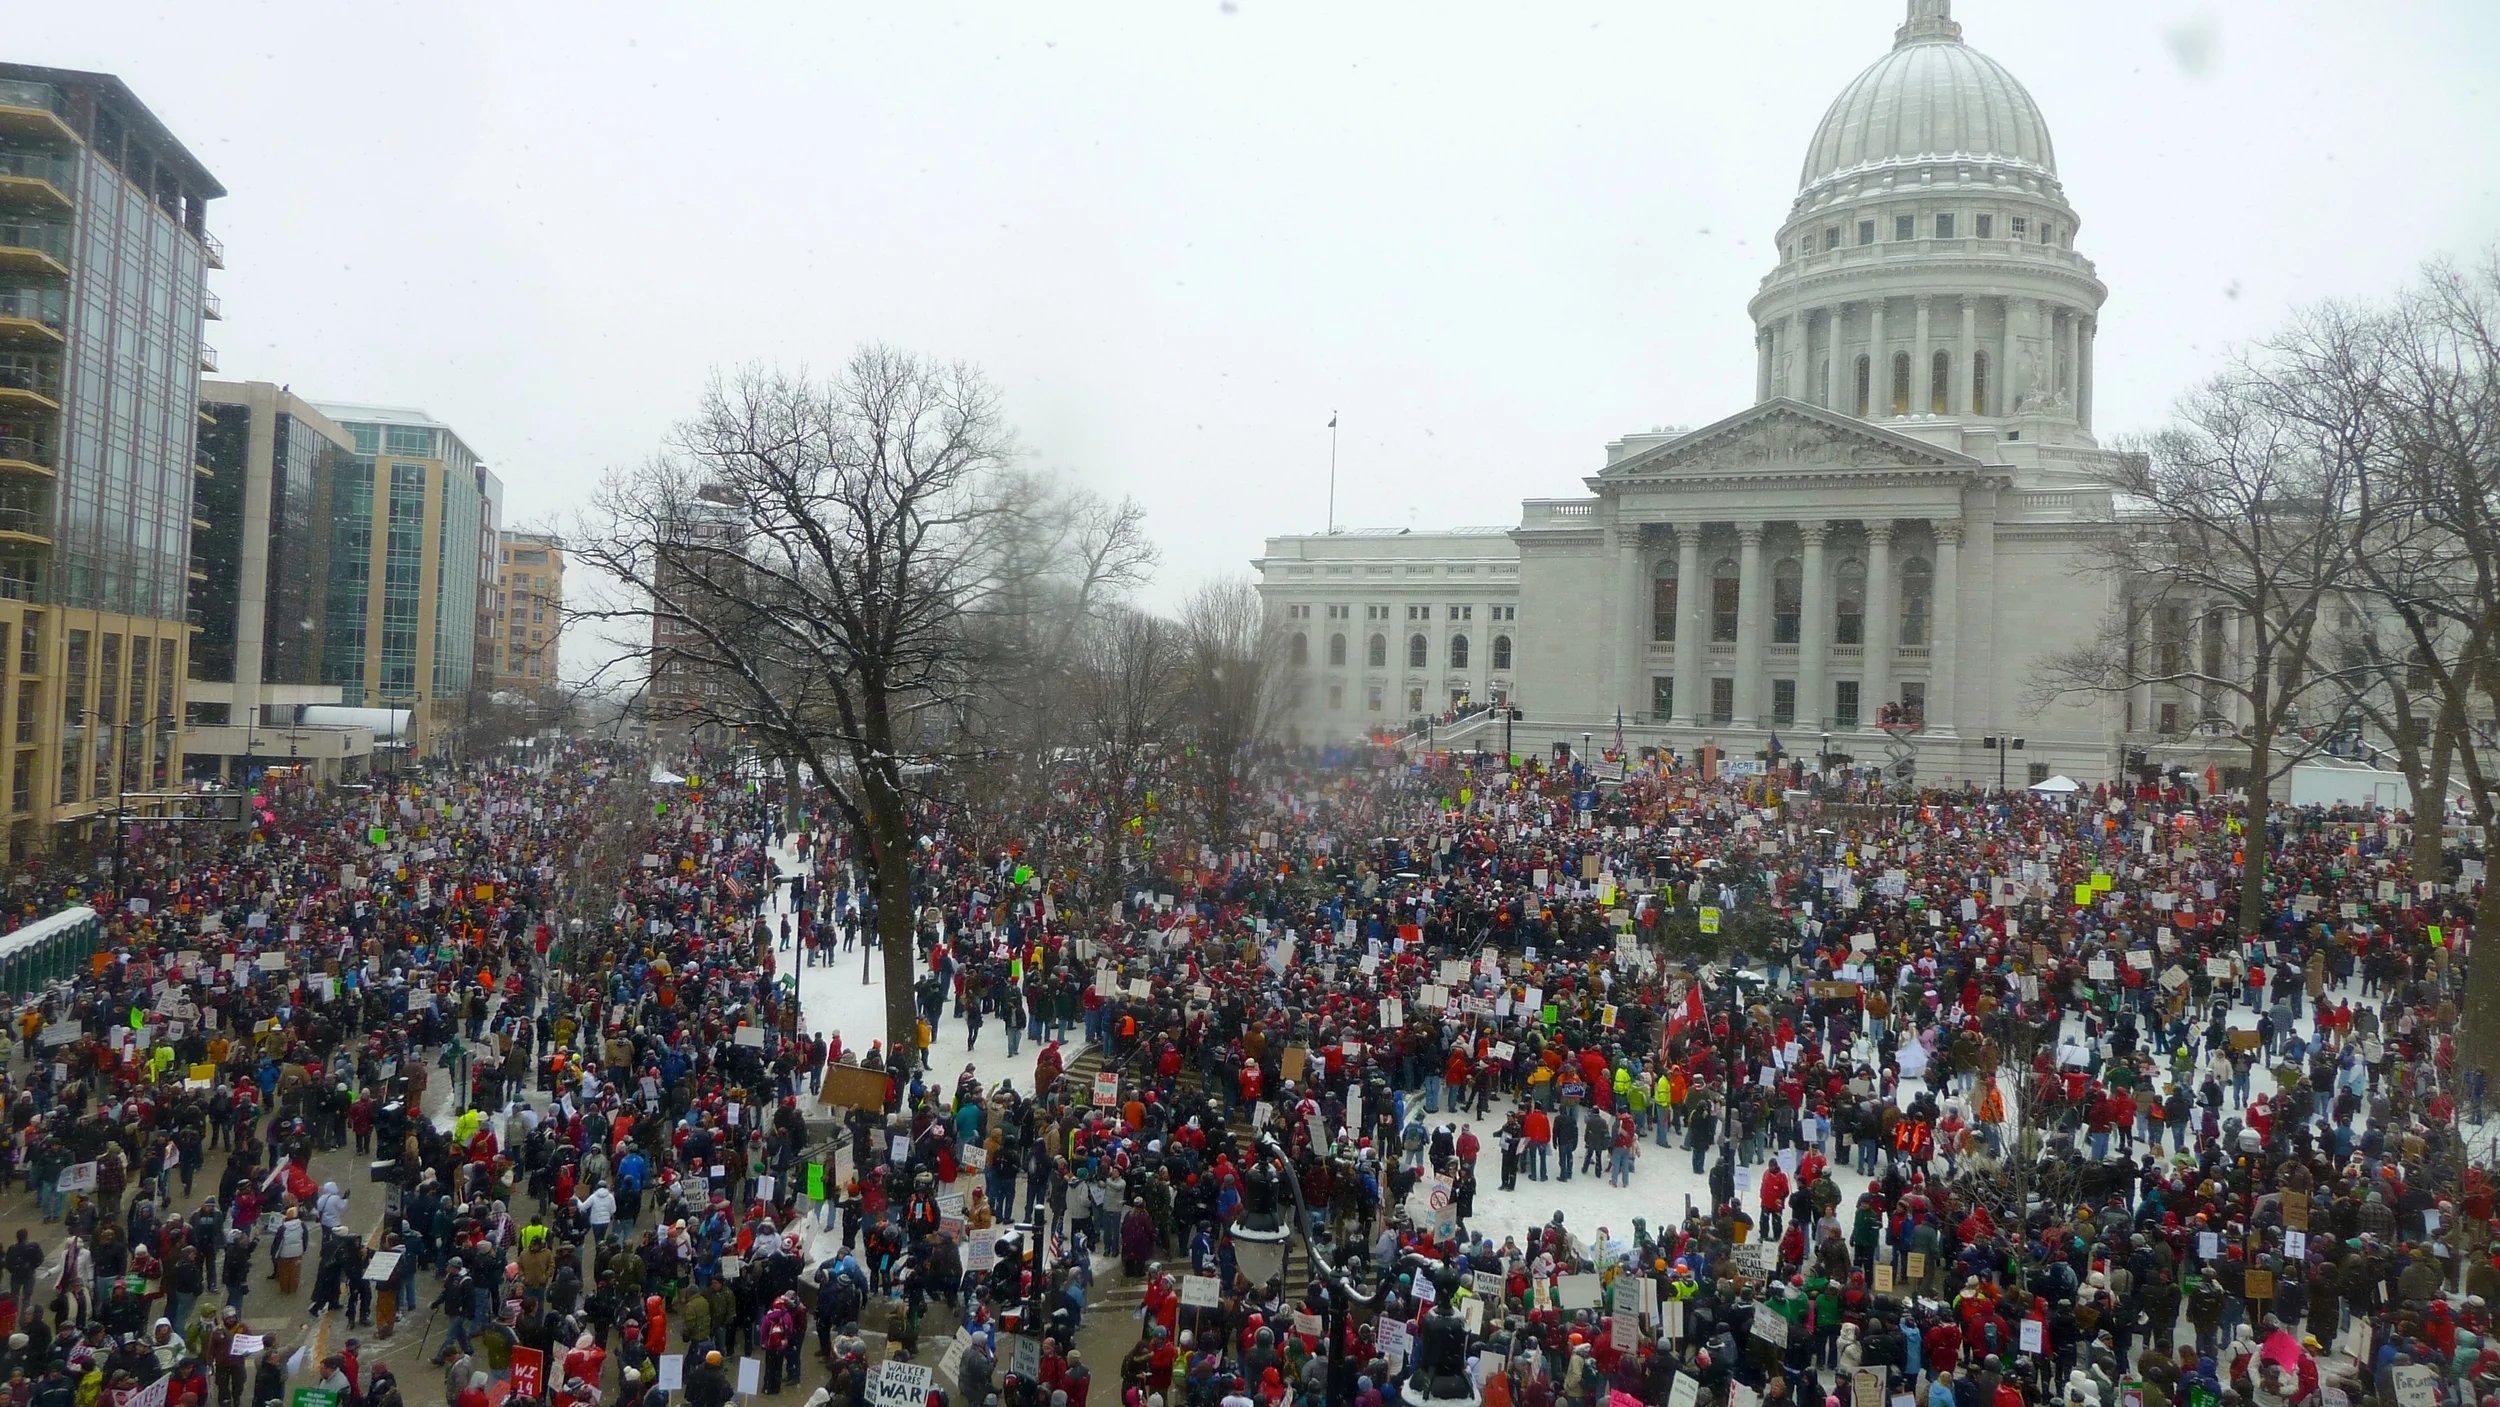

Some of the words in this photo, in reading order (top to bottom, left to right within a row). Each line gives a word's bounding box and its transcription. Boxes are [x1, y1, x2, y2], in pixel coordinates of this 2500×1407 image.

[1098, 1072, 1116, 1084] SAVE
[966, 1146, 984, 1157] CLOSED
[1736, 1257, 1763, 1269] RECALL
[1022, 1339, 1034, 1353] NO
[1020, 1352, 1034, 1365] TURN
[514, 1362, 538, 1379] WI
[888, 1362, 925, 1378] WALKER
[1016, 1361, 1025, 1371] ON
[1026, 1364, 1037, 1377] RED
[868, 1370, 880, 1384] SAVE
[886, 1371, 921, 1386] DECLARES
[880, 1380, 928, 1404] WAR!
[2410, 1391, 2427, 1400] NOT
